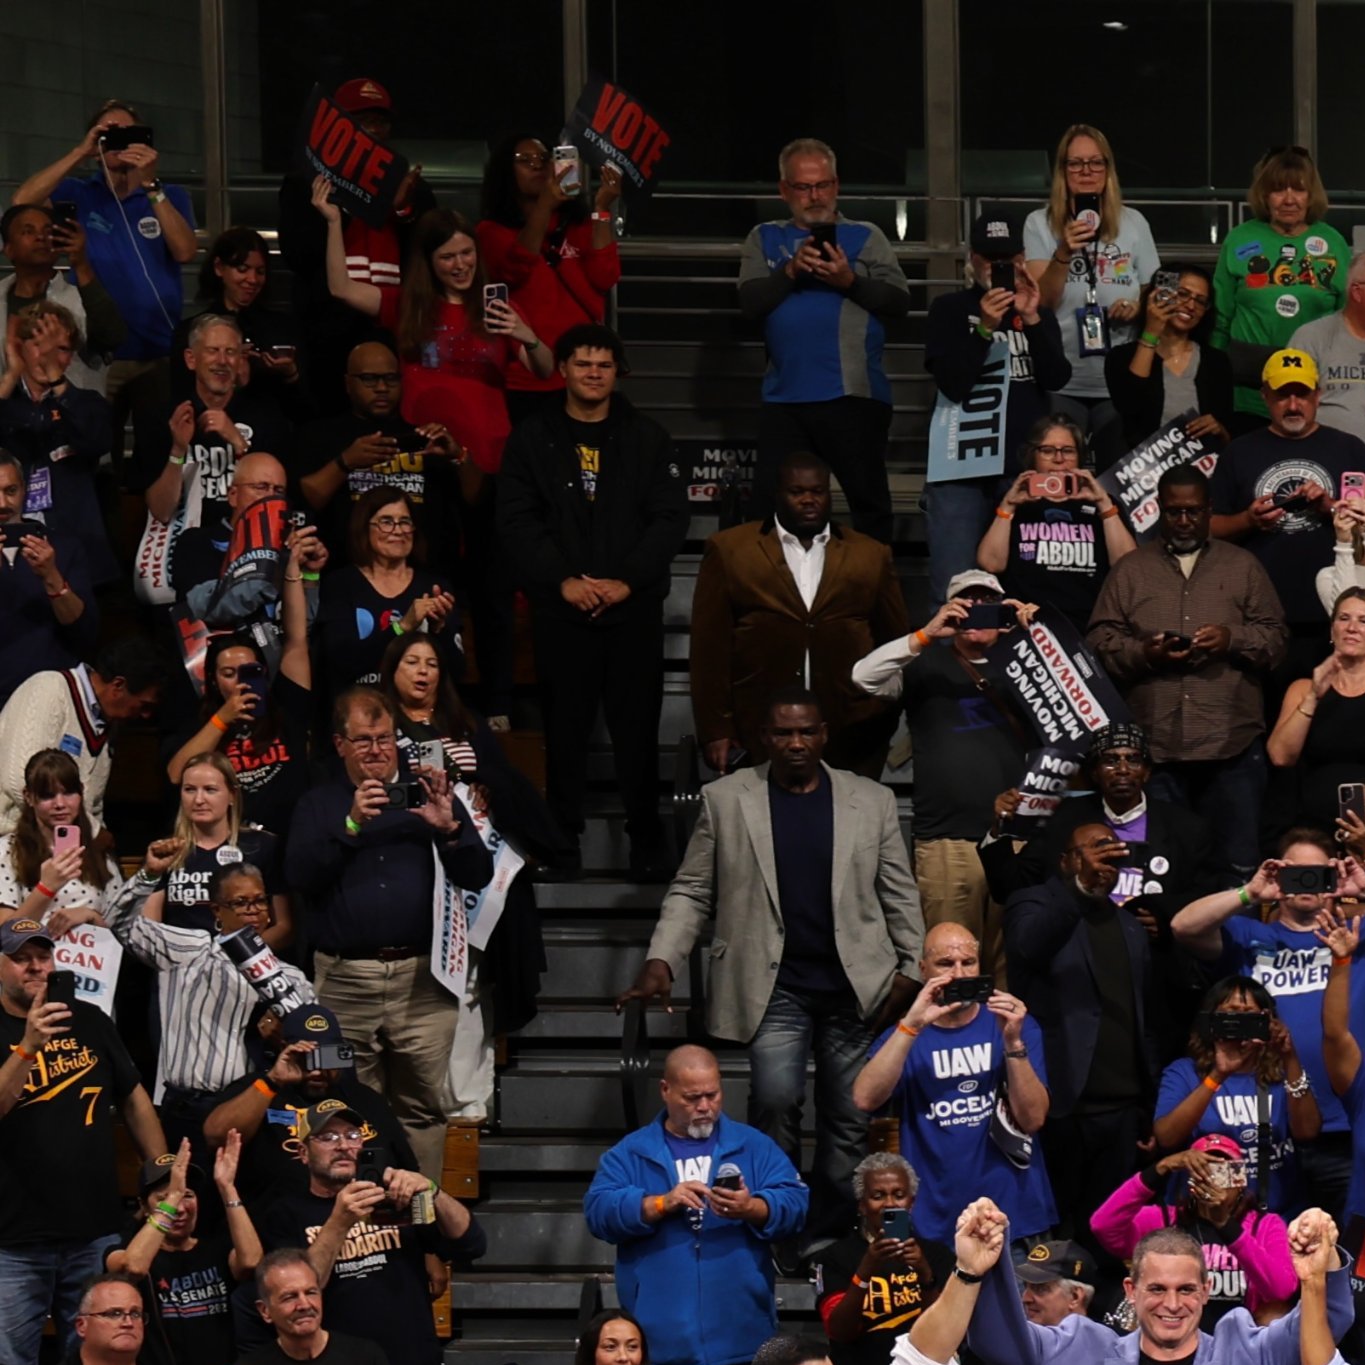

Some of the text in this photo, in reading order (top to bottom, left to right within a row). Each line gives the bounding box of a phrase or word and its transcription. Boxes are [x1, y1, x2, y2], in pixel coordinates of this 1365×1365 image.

[308, 97, 396, 197] VOTE
[589, 81, 672, 181] VOTE
[1283, 355, 1303, 368] M
[1115, 426, 1186, 484] MOVING
[1120, 439, 1205, 507] MICHIGAN
[1020, 522, 1095, 543] WOMEN
[1019, 541, 1097, 568] FOR ABDUL
[1012, 638, 1085, 743] MICHIGAN
[1032, 621, 1110, 730] FORWARD
[1005, 661, 1063, 744] MOVING
[167, 885, 213, 908] Righ
[1271, 950, 1318, 969] UAW
[1262, 964, 1332, 988] POWER
[44, 1038, 79, 1052] AFGE
[932, 1042, 993, 1079] UAW
[79, 1087, 103, 1126] 7
[170, 1266, 222, 1294] ABDUL
[180, 1281, 228, 1305] SENATE
